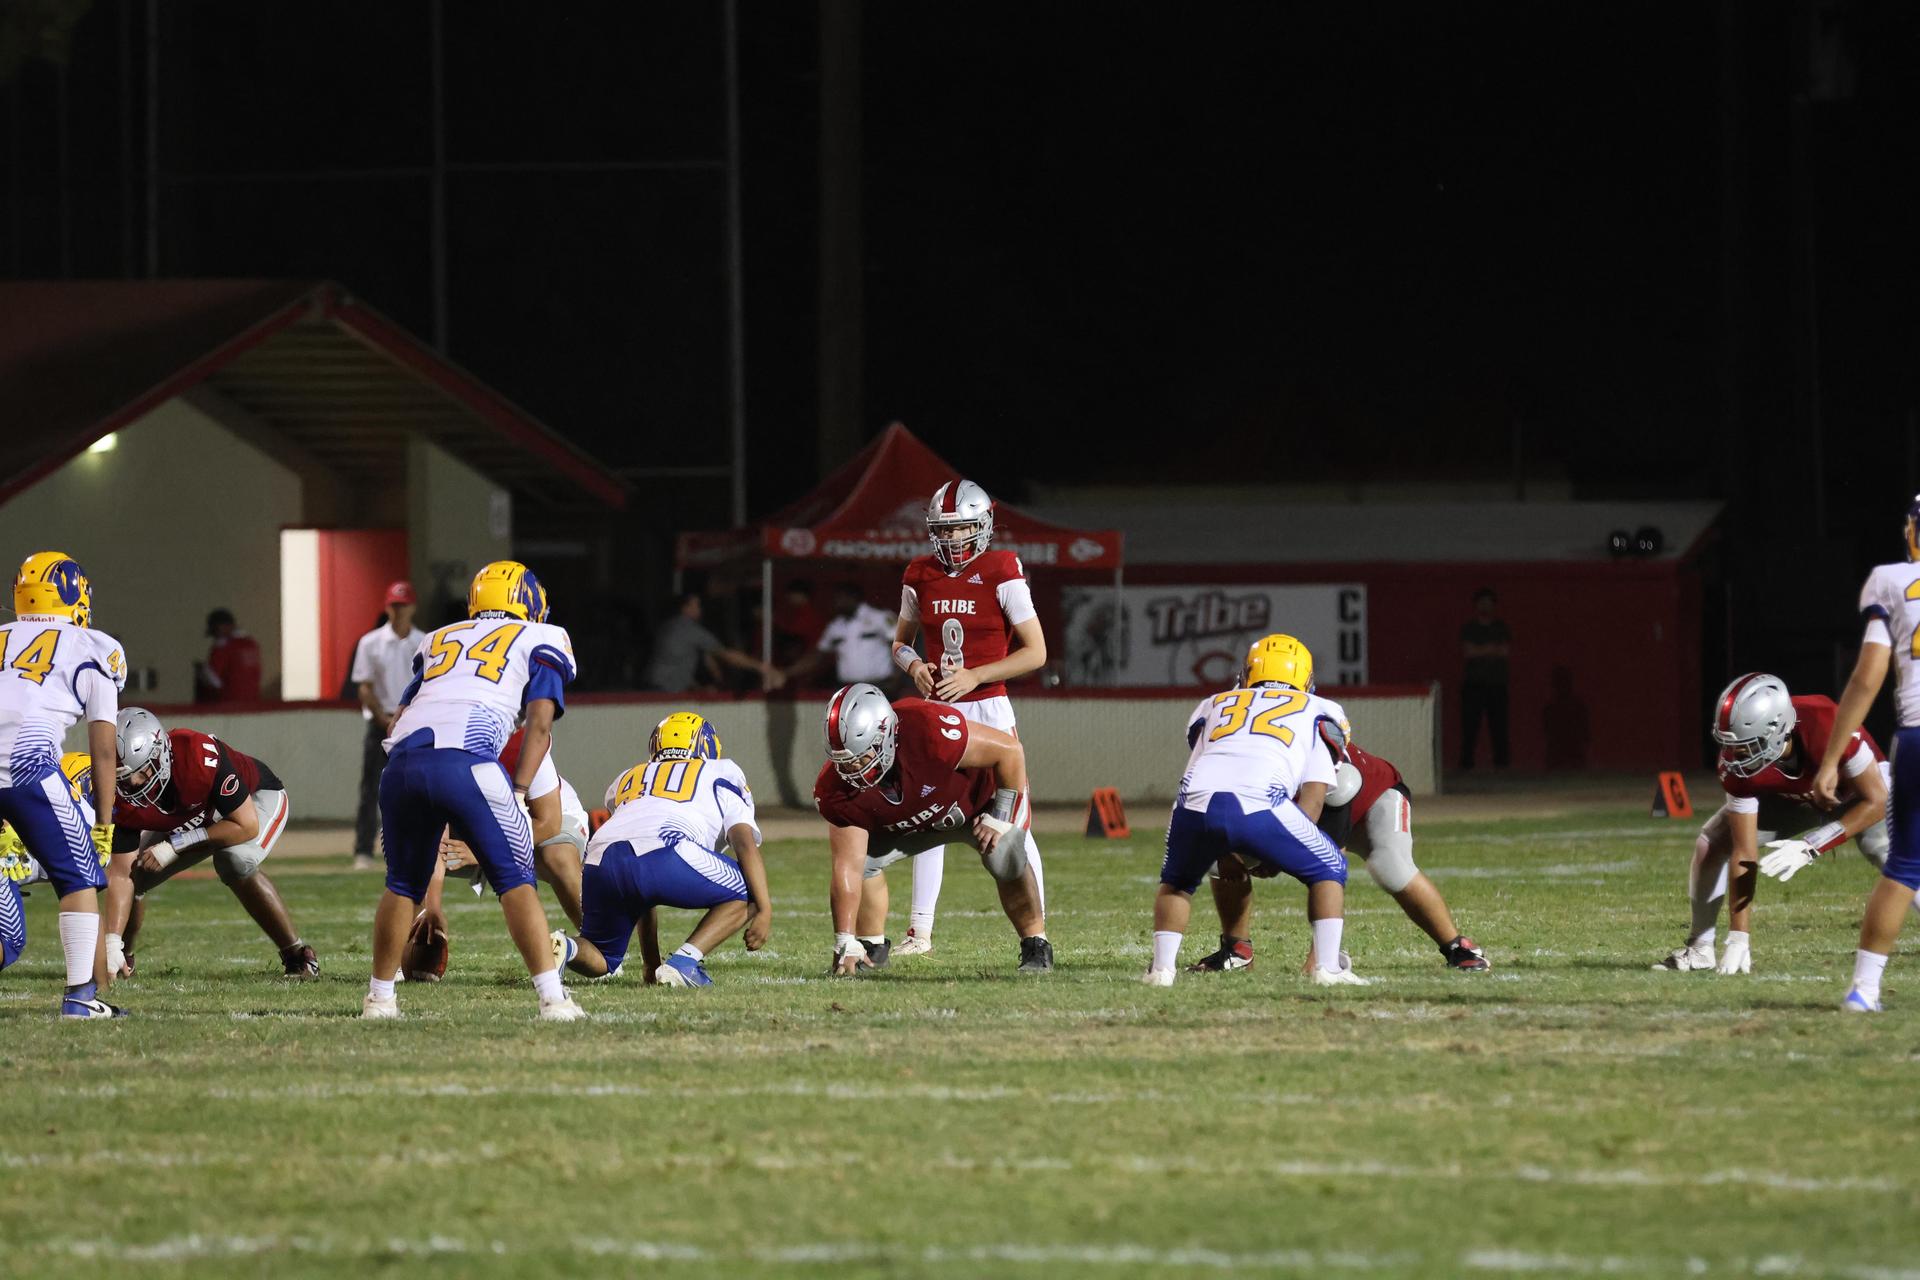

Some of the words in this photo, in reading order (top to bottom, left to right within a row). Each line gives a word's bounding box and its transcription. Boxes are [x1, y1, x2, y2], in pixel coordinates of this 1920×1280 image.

[932, 599, 976, 615] TRIBE
[1147, 591, 1271, 645] Tribe
[0, 628, 62, 687] 4
[422, 623, 527, 685] 54
[941, 617, 964, 680] 8
[939, 714, 962, 741] 66
[1209, 689, 1310, 748] 32
[662, 747, 689, 756] schutt
[615, 759, 706, 806] 40
[884, 803, 944, 832] TRIBE
